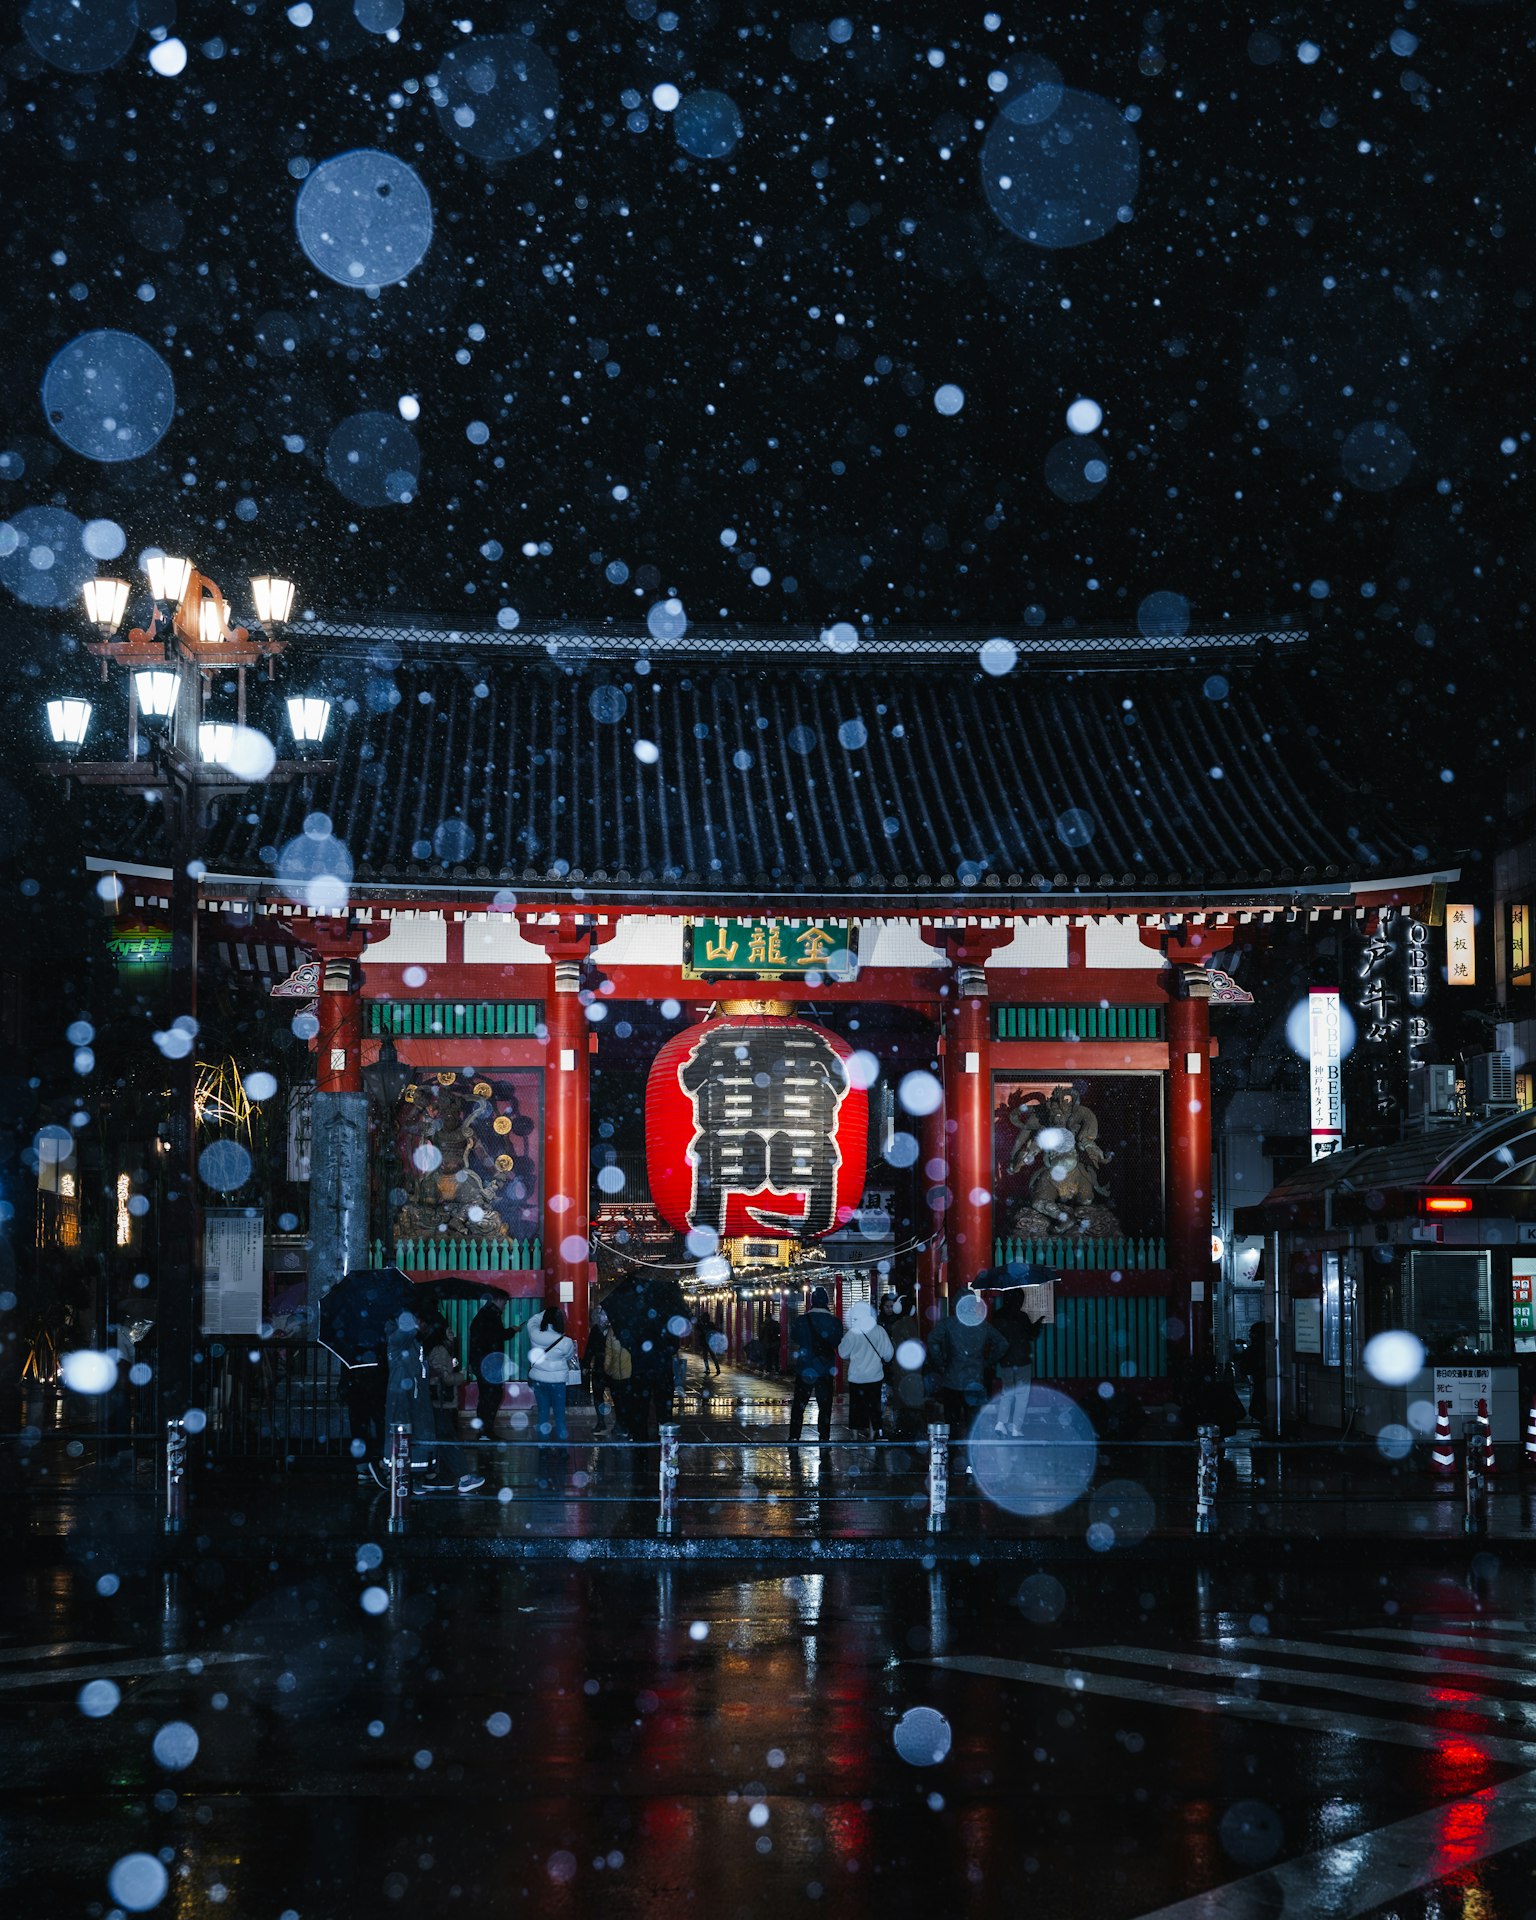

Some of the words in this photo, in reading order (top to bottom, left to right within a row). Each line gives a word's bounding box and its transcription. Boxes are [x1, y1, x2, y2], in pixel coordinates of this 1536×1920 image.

[1453, 910, 1469, 977] 鉄板焼
[1326, 996, 1339, 1058] KOBE
[1327, 1065, 1339, 1126] BEEF
[677, 1022, 852, 1237] 雷門
[1436, 1384, 1454, 1393] 死亡
[1481, 1384, 1487, 1393] 2
